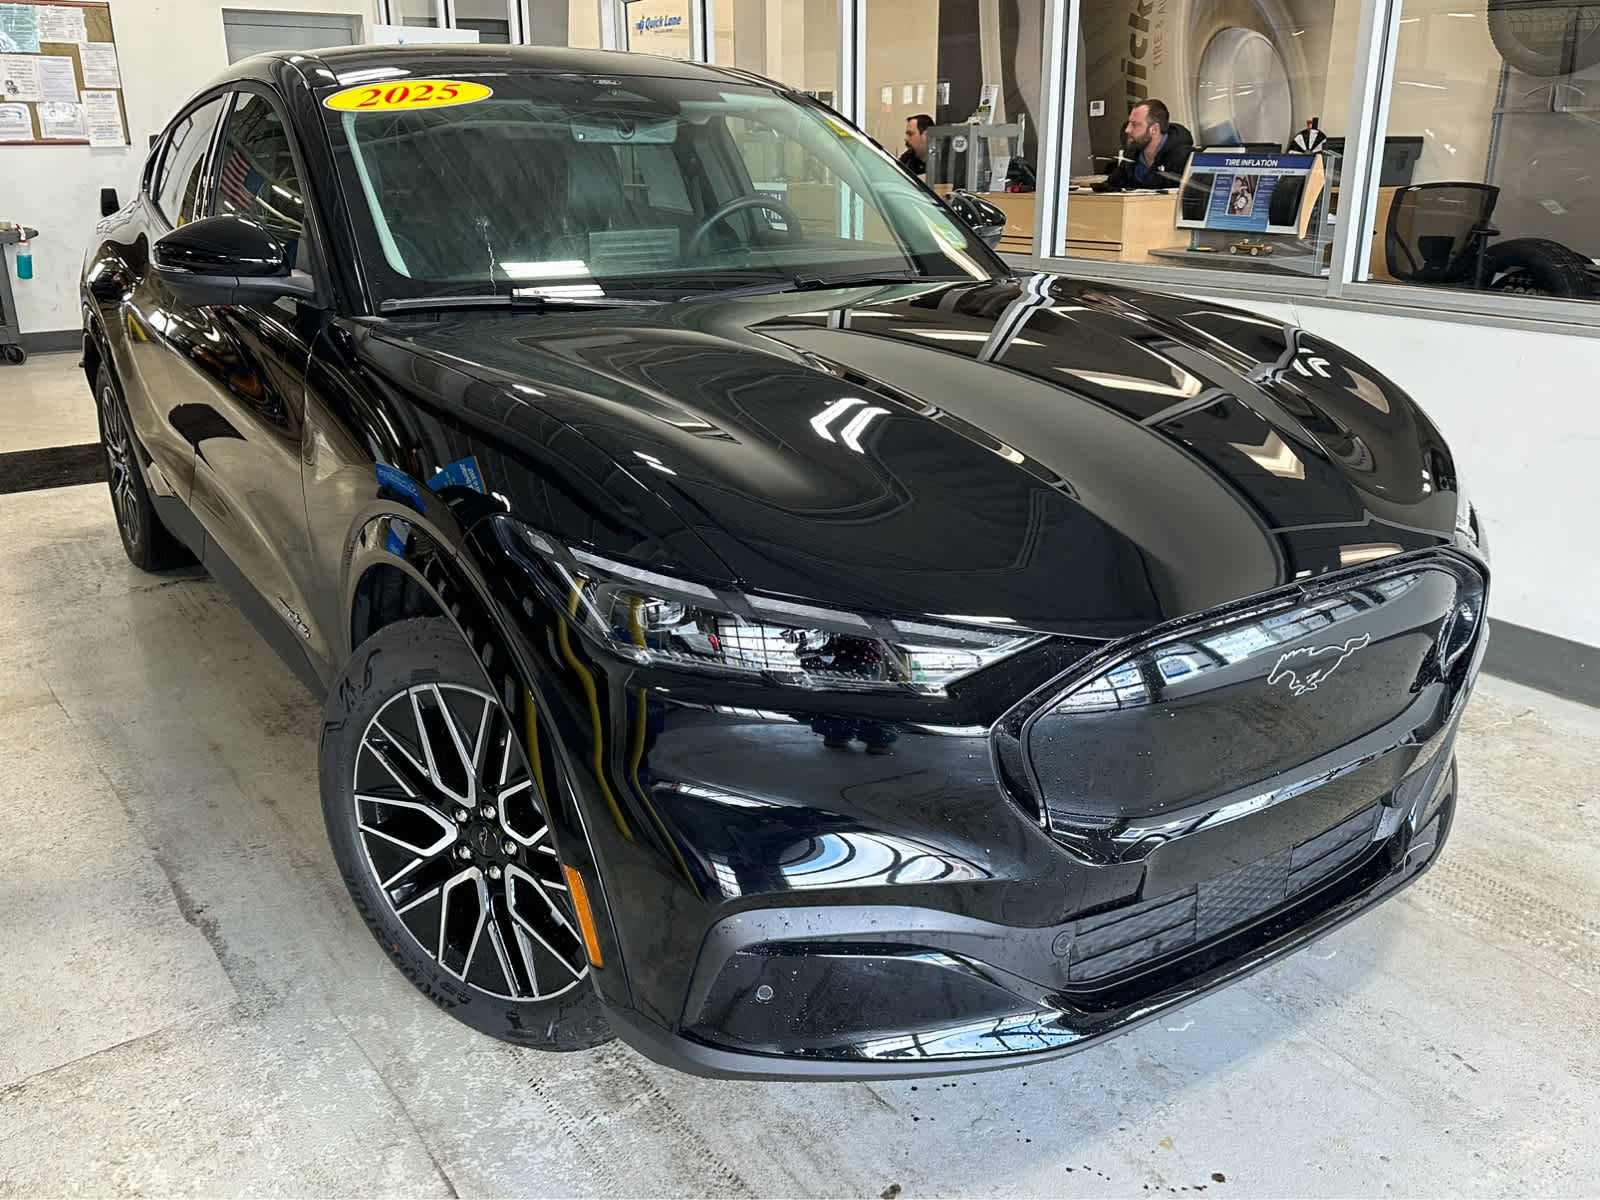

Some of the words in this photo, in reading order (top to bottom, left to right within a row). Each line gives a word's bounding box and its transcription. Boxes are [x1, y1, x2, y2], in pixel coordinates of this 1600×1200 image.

[645, 16, 664, 30] Quick
[664, 15, 682, 27] Lane
[1152, 31, 1162, 71] TIRE
[357, 84, 461, 107] 2025
[1225, 158, 1240, 166] TIRE
[1241, 159, 1279, 167] INFLATION
